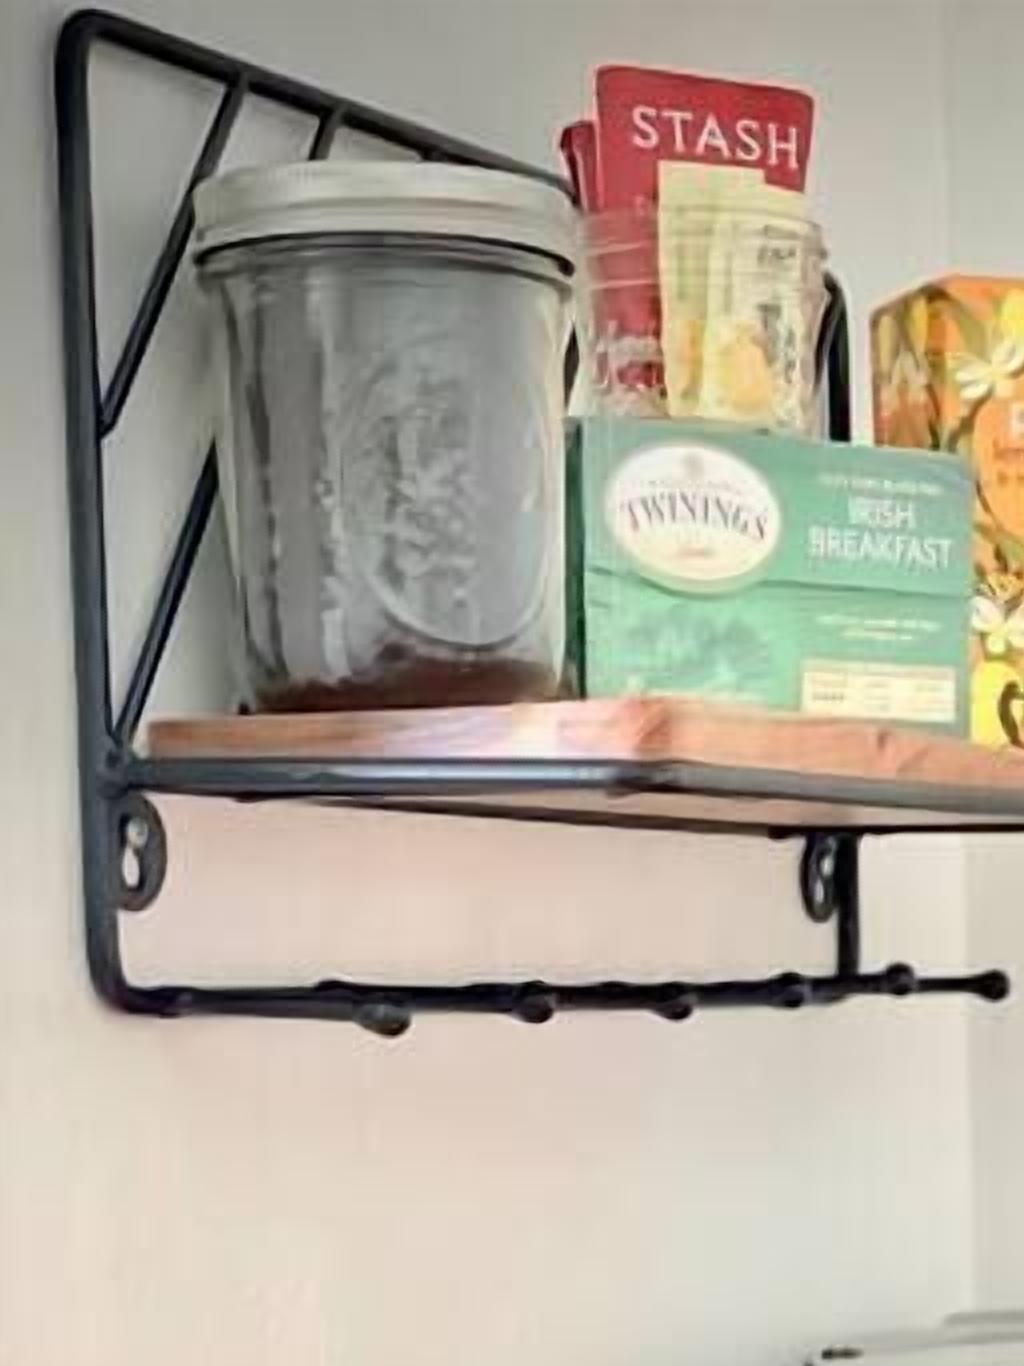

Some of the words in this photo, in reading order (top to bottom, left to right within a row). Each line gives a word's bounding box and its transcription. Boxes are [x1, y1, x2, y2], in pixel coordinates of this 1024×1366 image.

[632, 105, 799, 169] STASH
[619, 490, 770, 542] TWININGS
[808, 525, 952, 571] BREAKFAST
